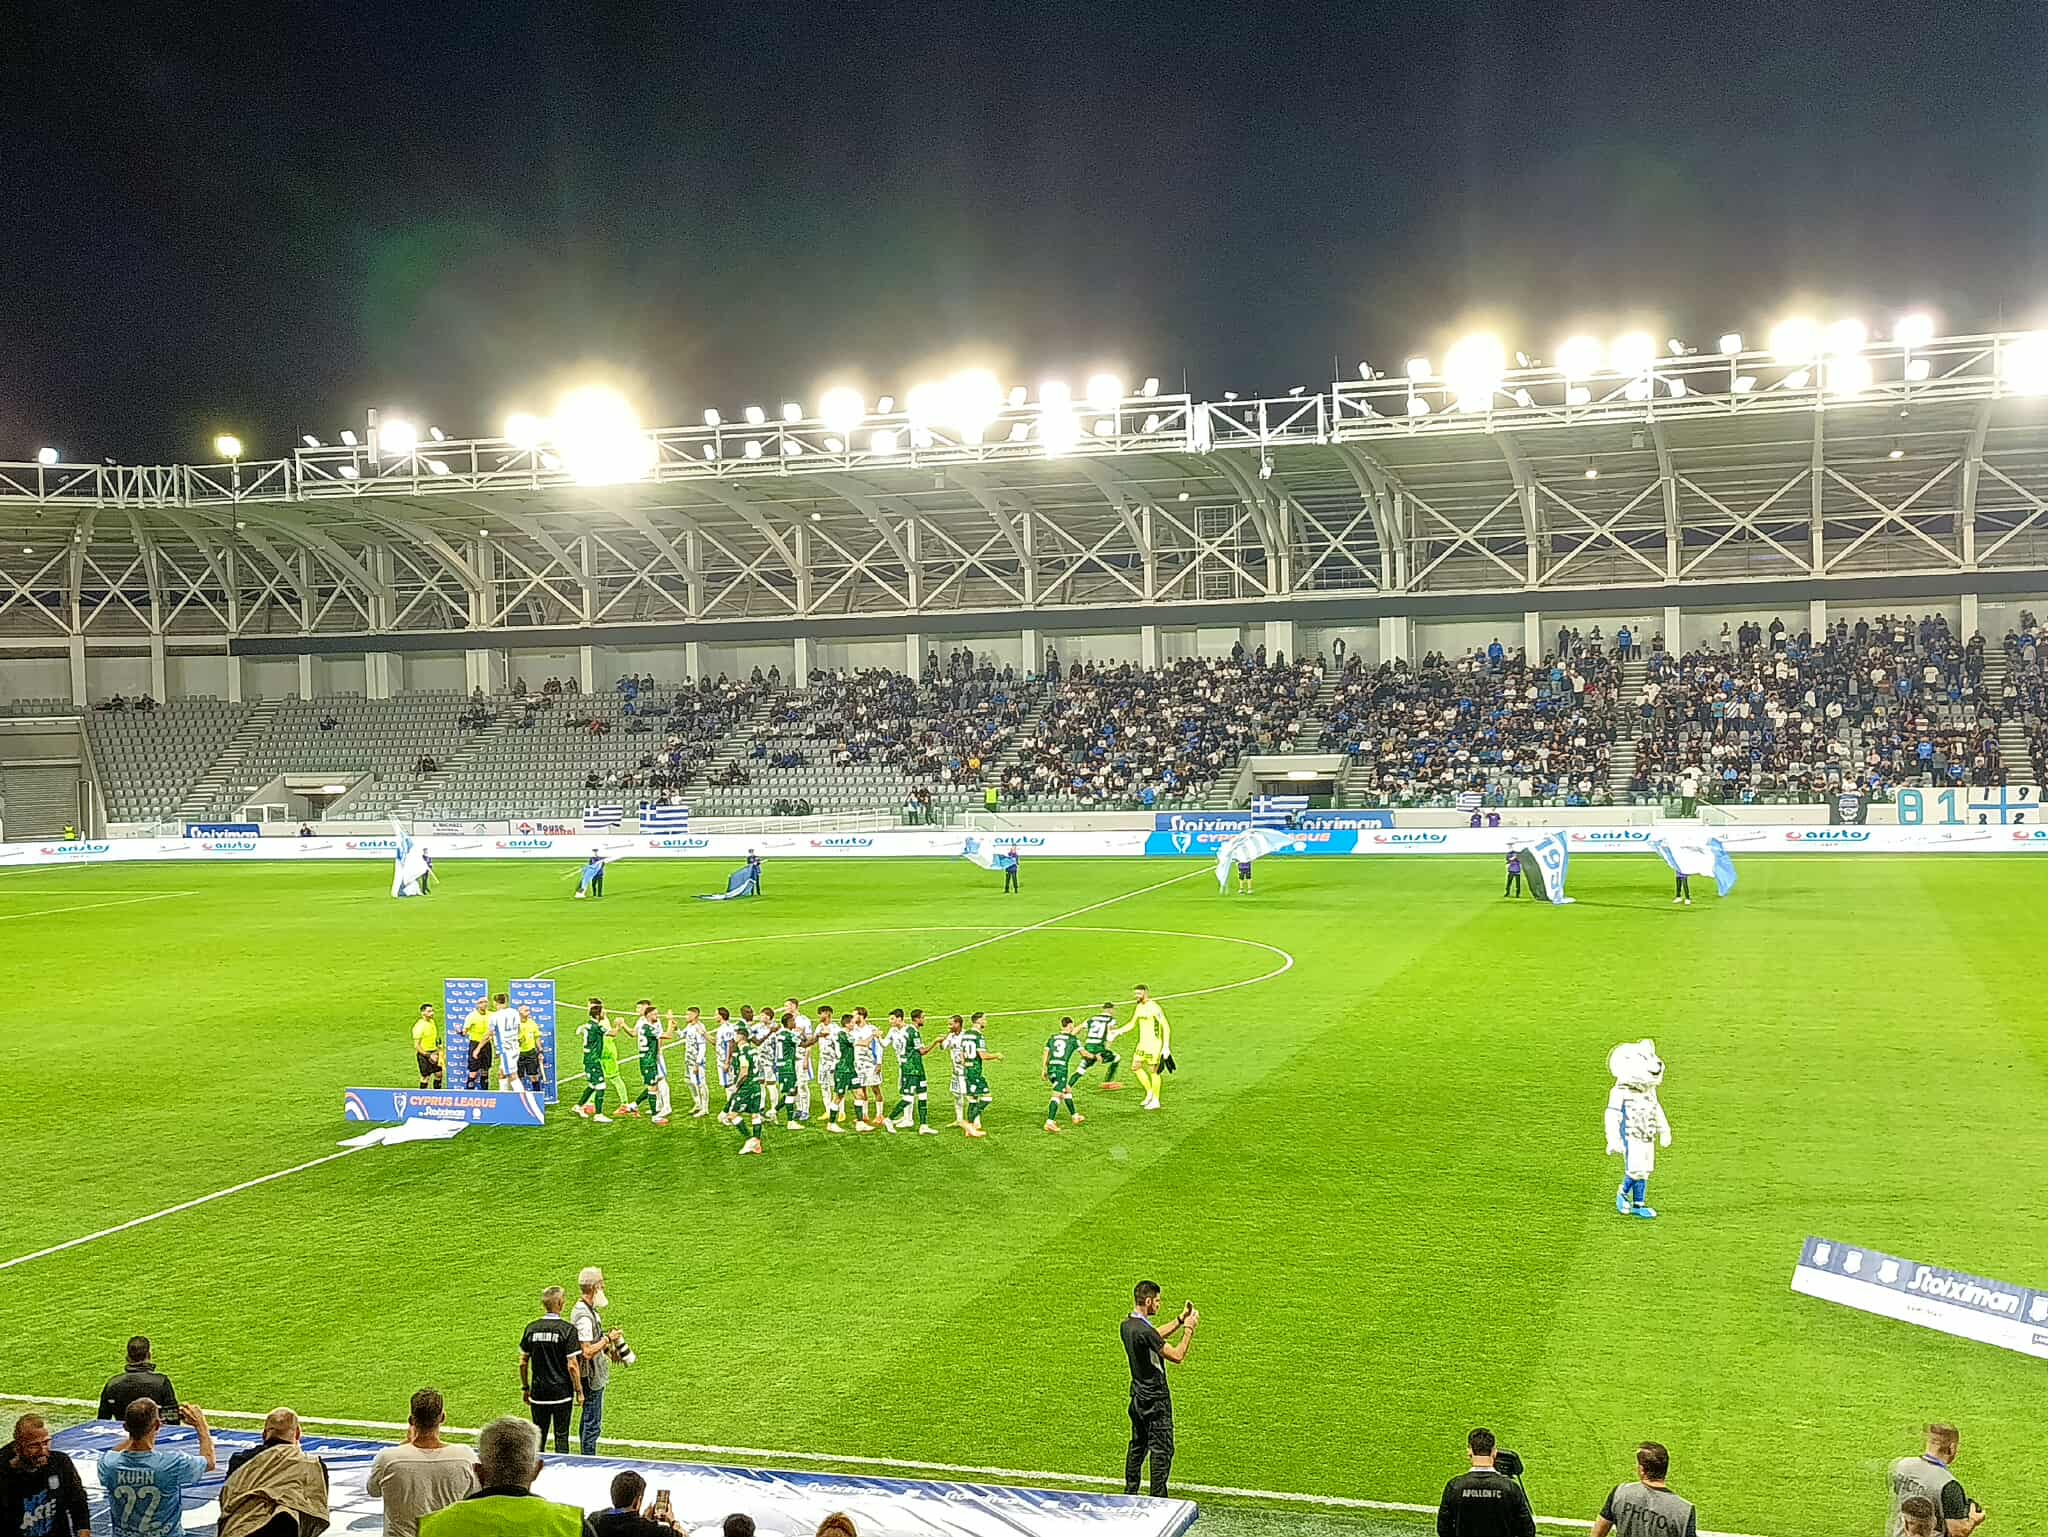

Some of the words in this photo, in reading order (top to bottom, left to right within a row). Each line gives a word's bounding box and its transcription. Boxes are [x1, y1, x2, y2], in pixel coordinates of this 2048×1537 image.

[1170, 815, 1250, 830] Stoixima
[1391, 832, 1448, 842] aristos
[1589, 830, 1653, 841] aristos
[1804, 829, 1872, 840] aristos
[215, 841, 257, 850] aristos
[358, 840, 397, 848] aristo
[508, 839, 553, 848] aristos
[663, 837, 710, 847] aristos
[824, 837, 874, 847] aristos
[57, 843, 111, 852] aristos
[1053, 1039, 1067, 1058] 3
[409, 1096, 454, 1108] CYPRUS
[454, 1097, 497, 1109] LEAGUE
[1906, 1266, 2020, 1314] Stoiximan
[117, 1470, 155, 1484] KUHN
[1462, 1489, 1492, 1498] APOLLON
[1493, 1489, 1502, 1499] FC
